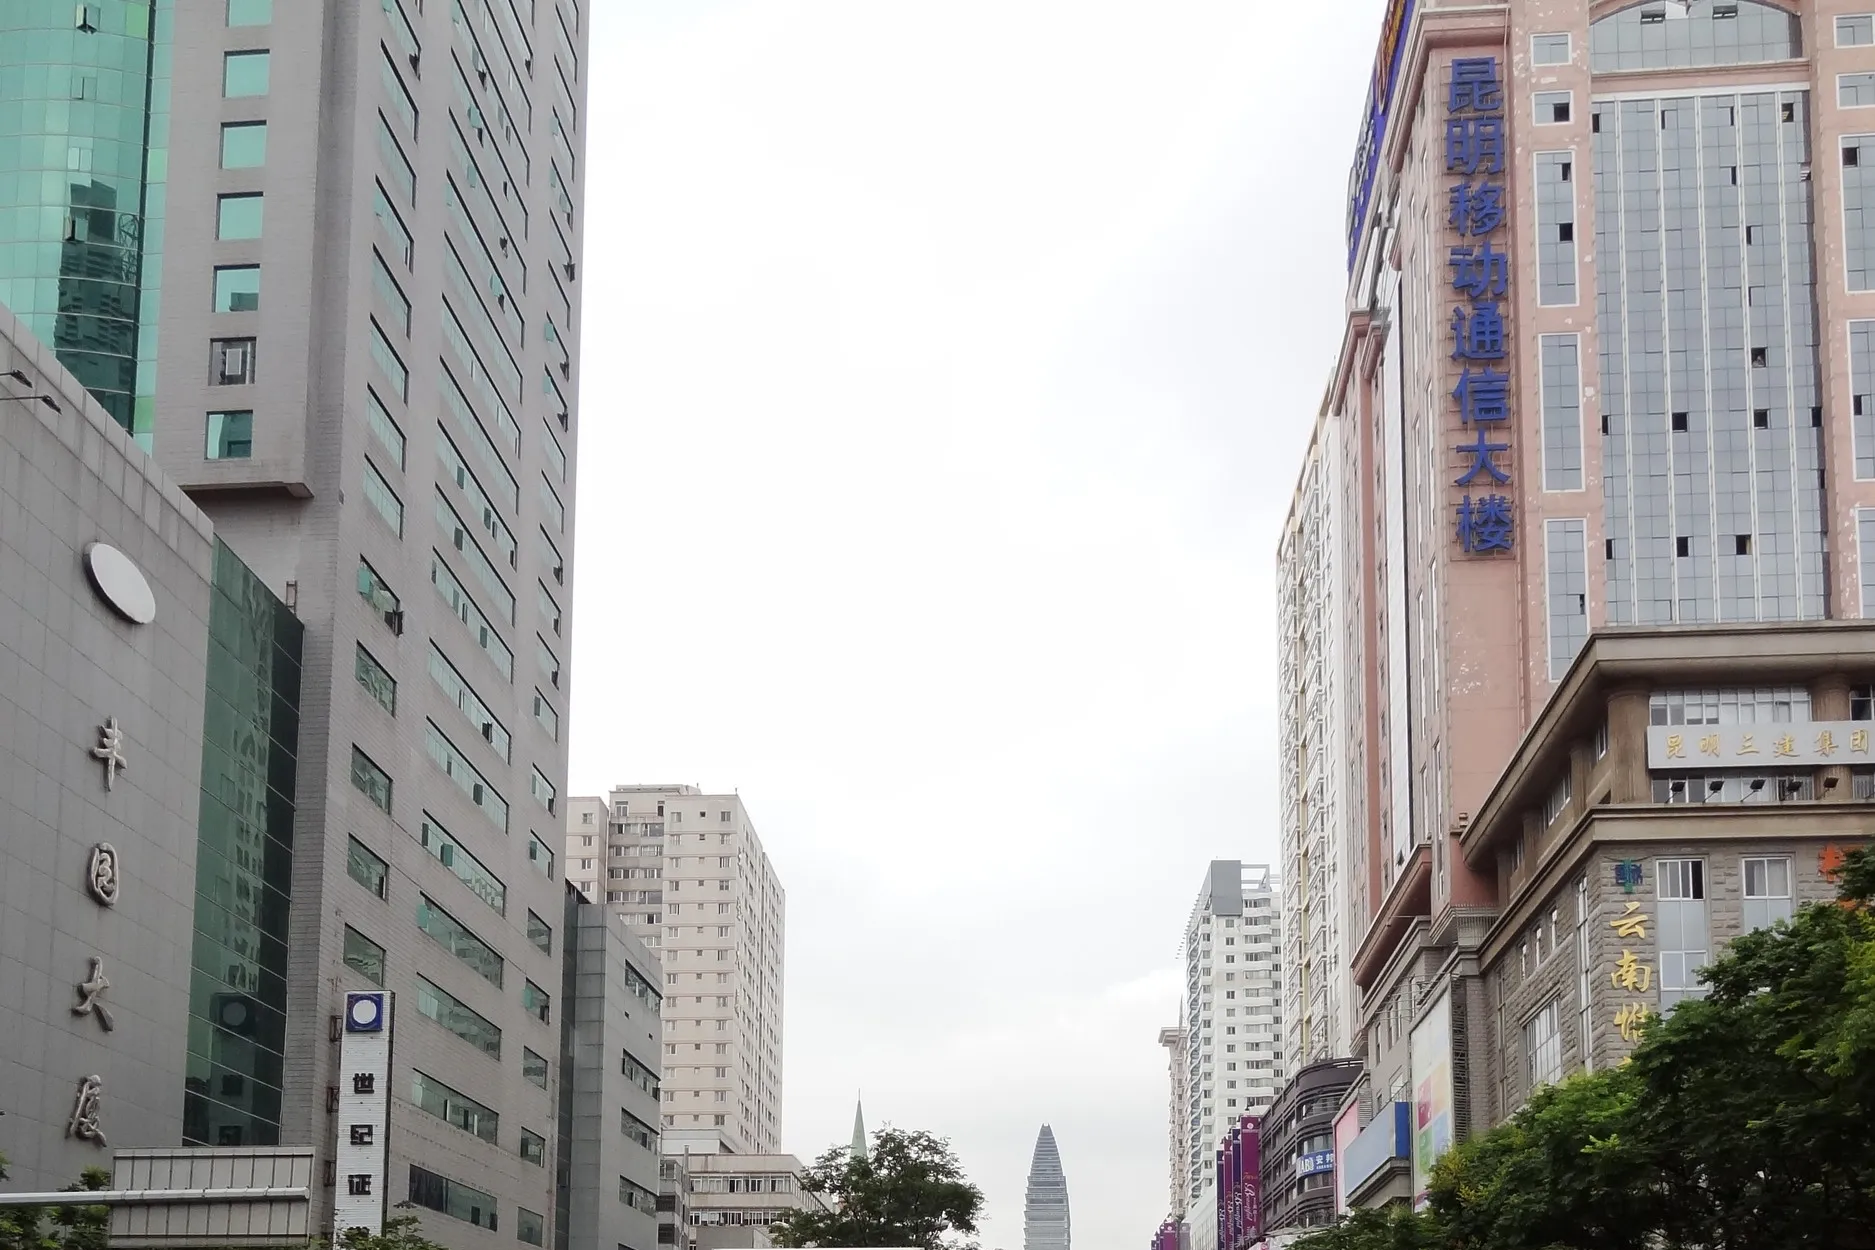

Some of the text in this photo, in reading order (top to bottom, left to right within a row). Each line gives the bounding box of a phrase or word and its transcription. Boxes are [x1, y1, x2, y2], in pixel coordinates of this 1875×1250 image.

[1447, 56, 1513, 552] 昆明移动通信大楼
[1666, 729, 1868, 759] 昆明三建集团
